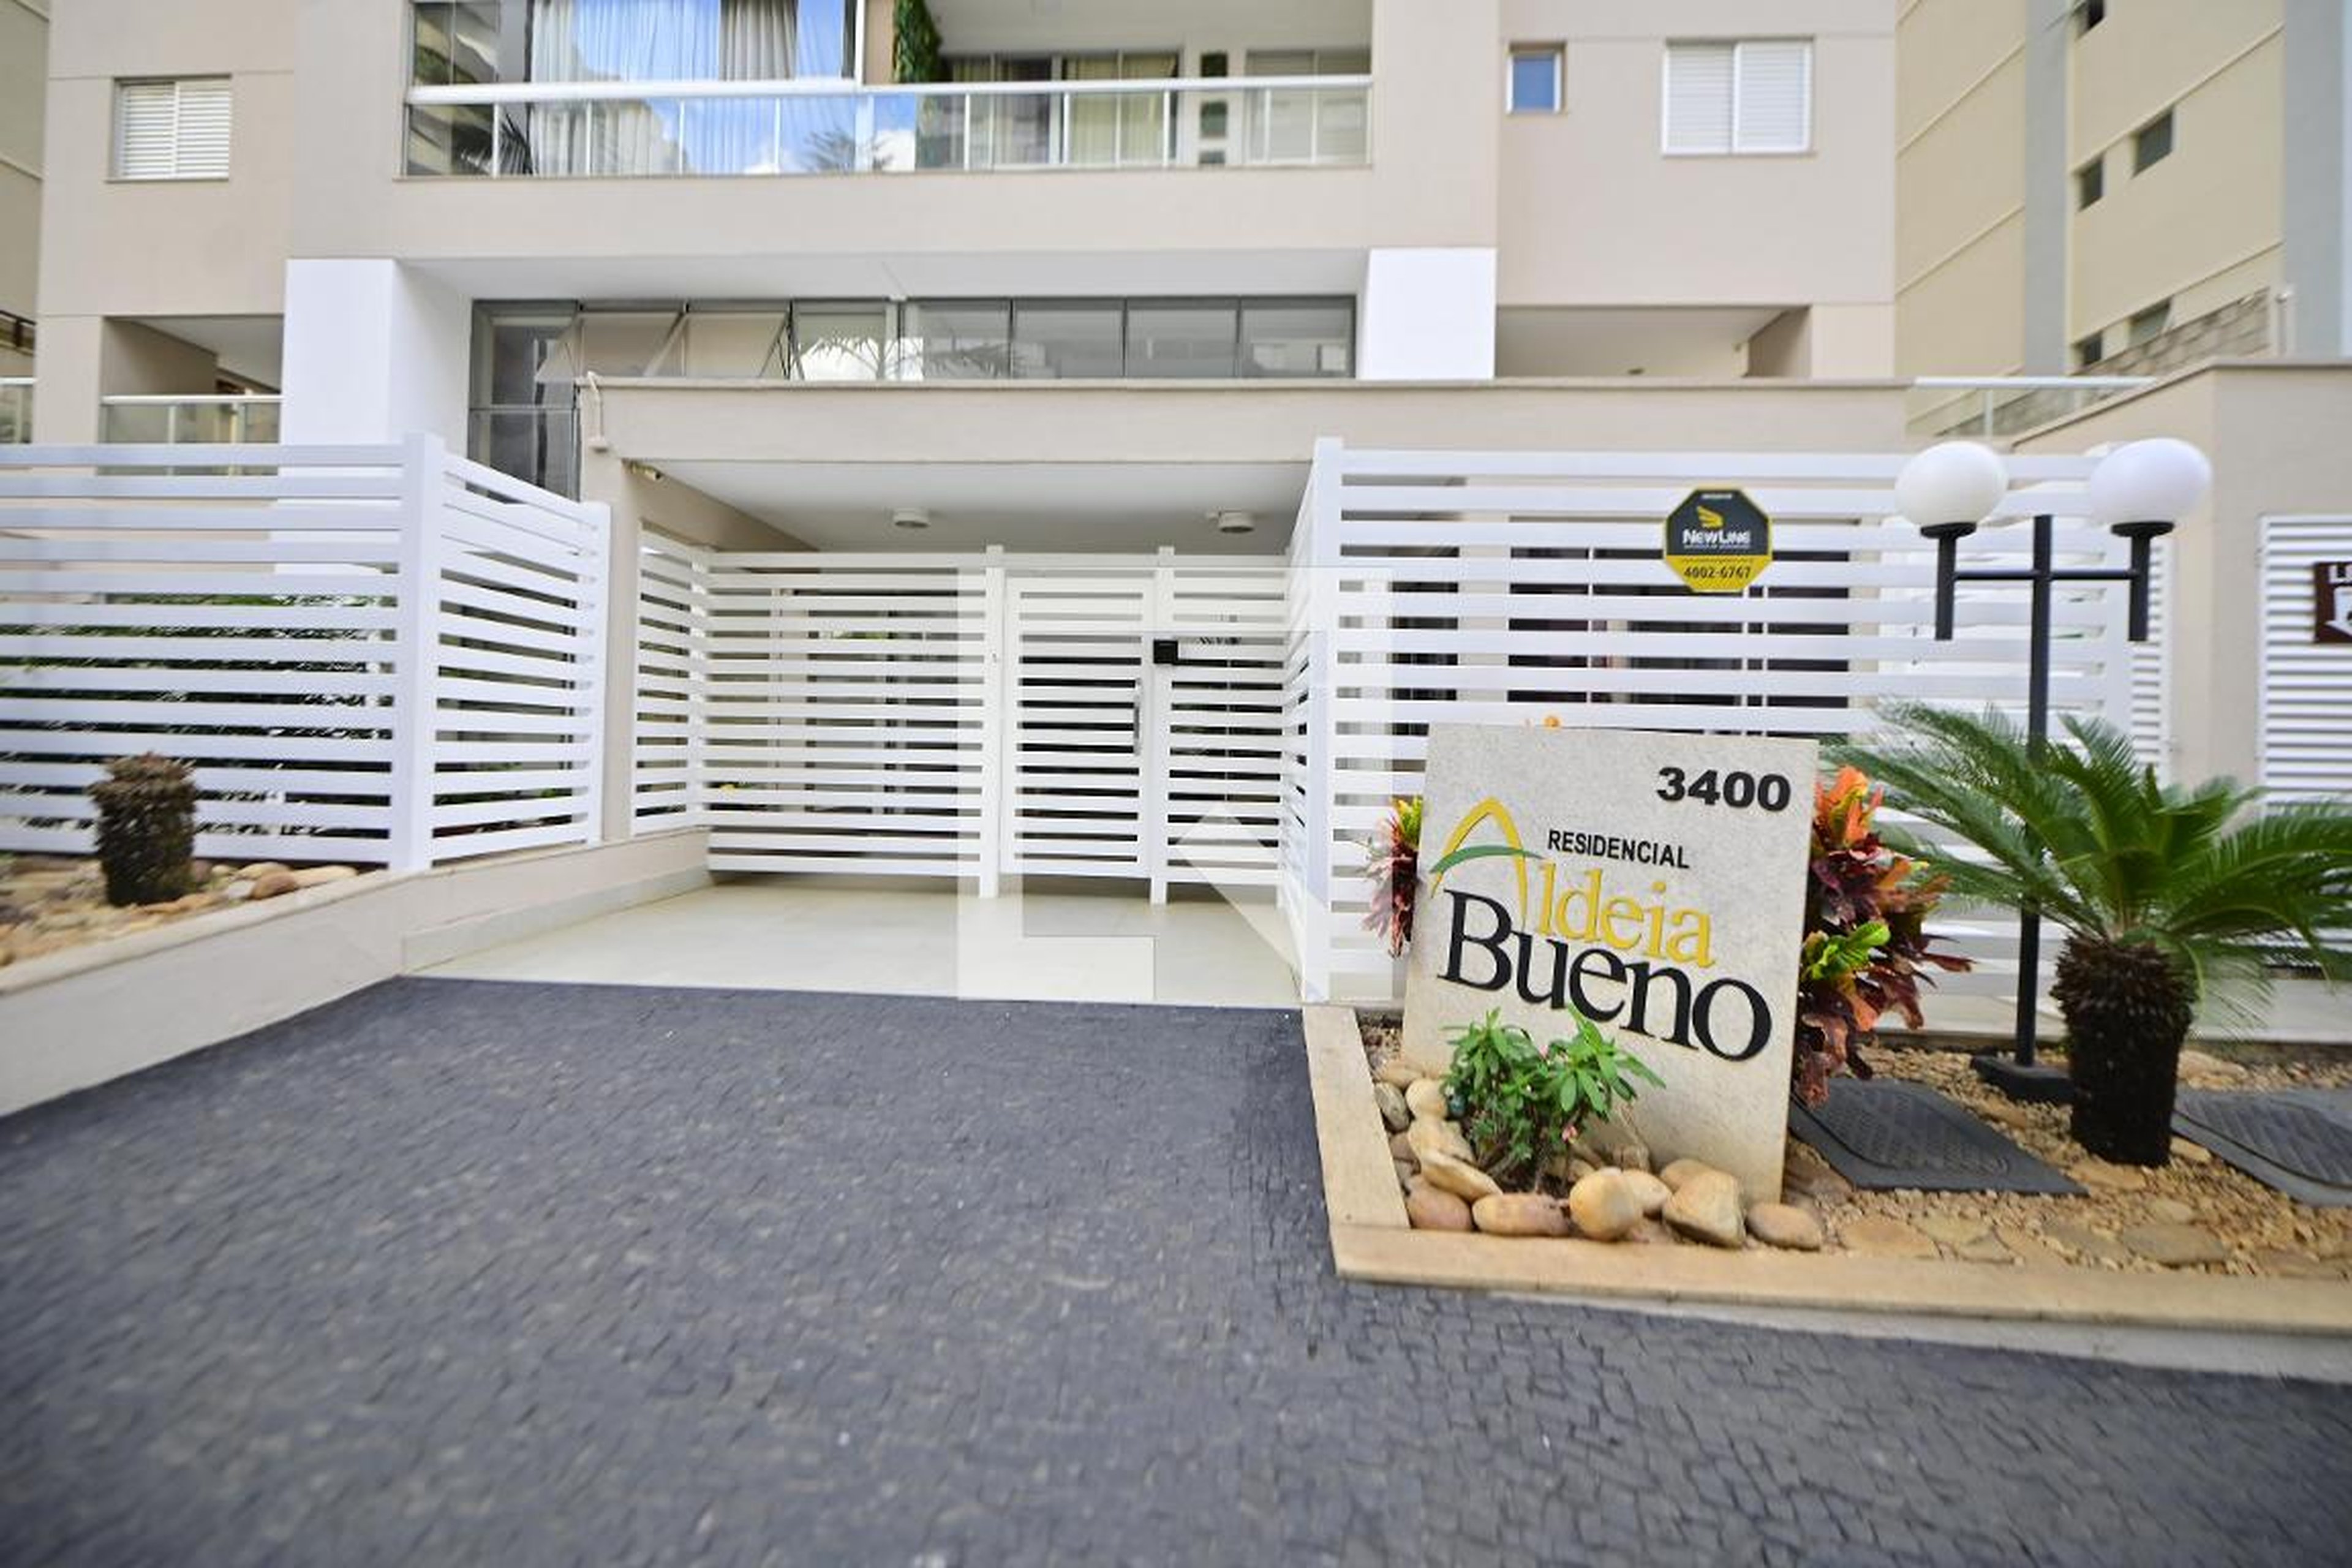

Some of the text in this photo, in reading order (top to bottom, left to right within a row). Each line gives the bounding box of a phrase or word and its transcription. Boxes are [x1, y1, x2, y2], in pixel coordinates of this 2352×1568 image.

[1657, 767, 1791, 812] 3400
[1430, 797, 1716, 968] Aldeia
[1547, 829, 1690, 869] RESIDENCIAL
[1436, 888, 1773, 1062] Bueno
